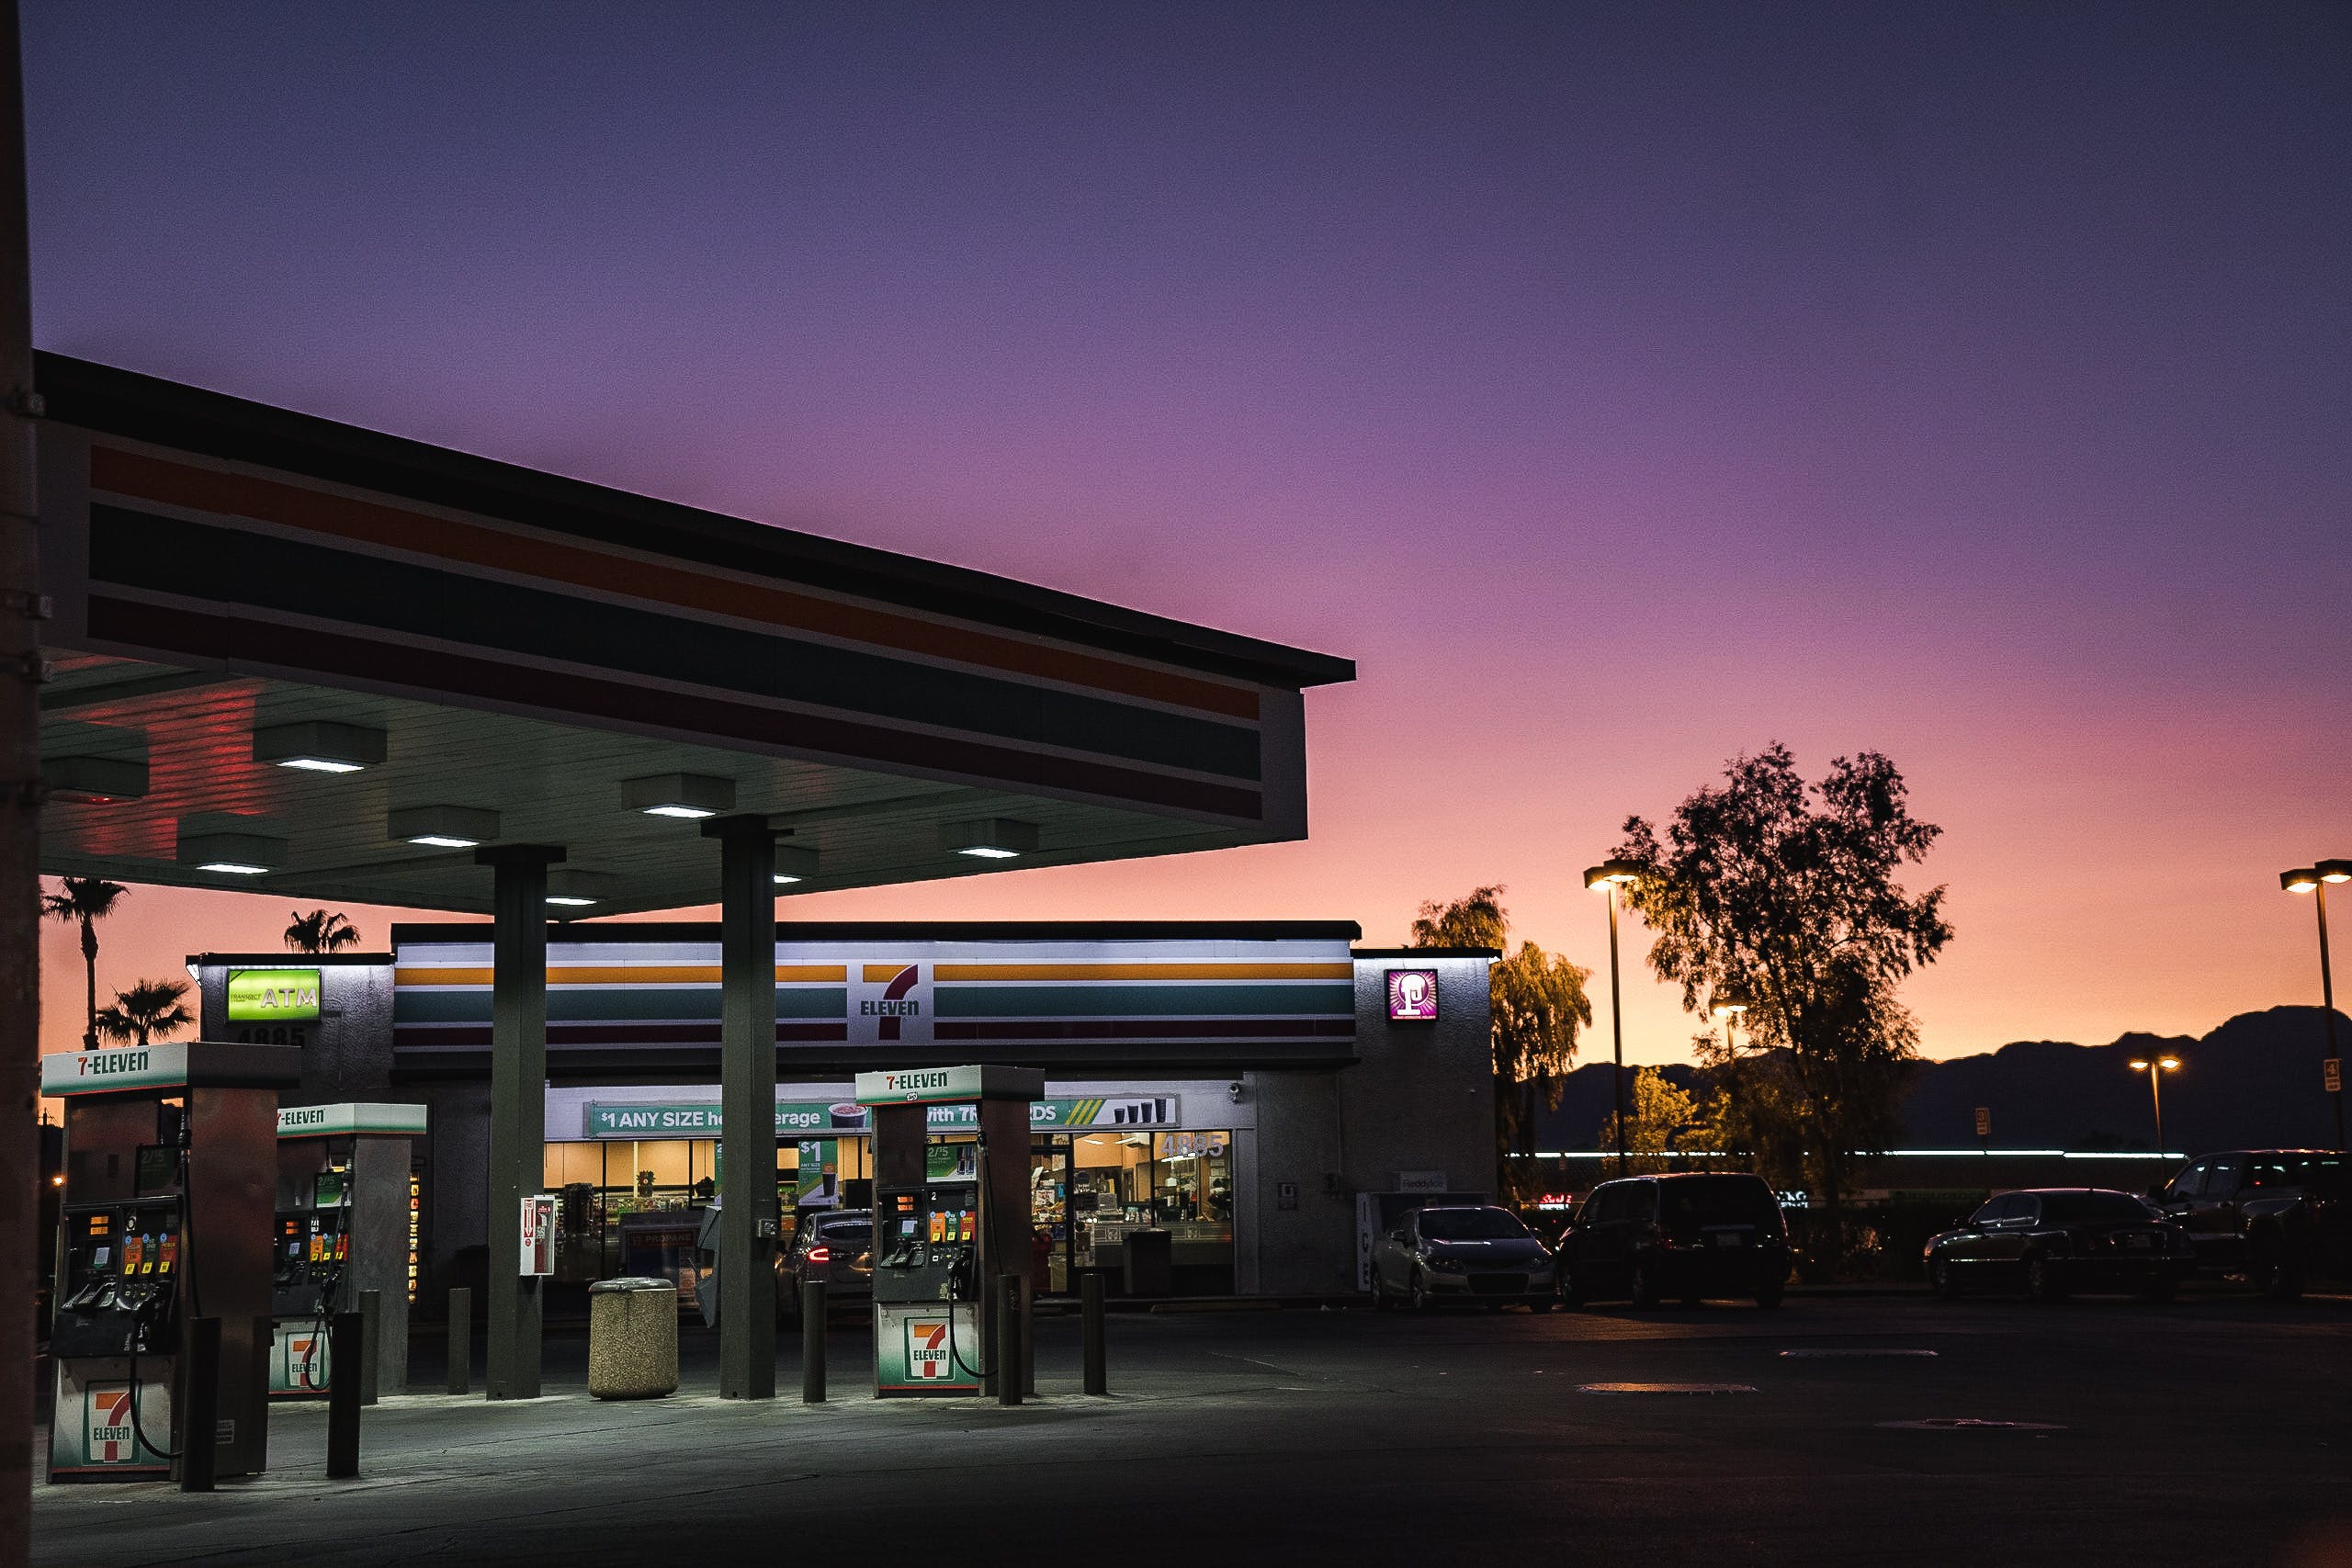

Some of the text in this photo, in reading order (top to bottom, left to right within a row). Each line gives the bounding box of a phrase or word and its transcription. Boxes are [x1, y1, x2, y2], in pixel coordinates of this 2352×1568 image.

[260, 987, 317, 1009] ATM
[863, 964, 919, 1041] 7
[601, 1111, 616, 1128] $1
[618, 1111, 661, 1128] ANY
[662, 1111, 704, 1127] SIZE
[800, 1141, 821, 1162] $1
[1161, 1134, 1224, 1157] 4885
[931, 1192, 937, 1201] 2
[645, 1233, 692, 1243] PROPANE
[1362, 1201, 1370, 1285] ICE
[913, 1324, 946, 1378] 7
